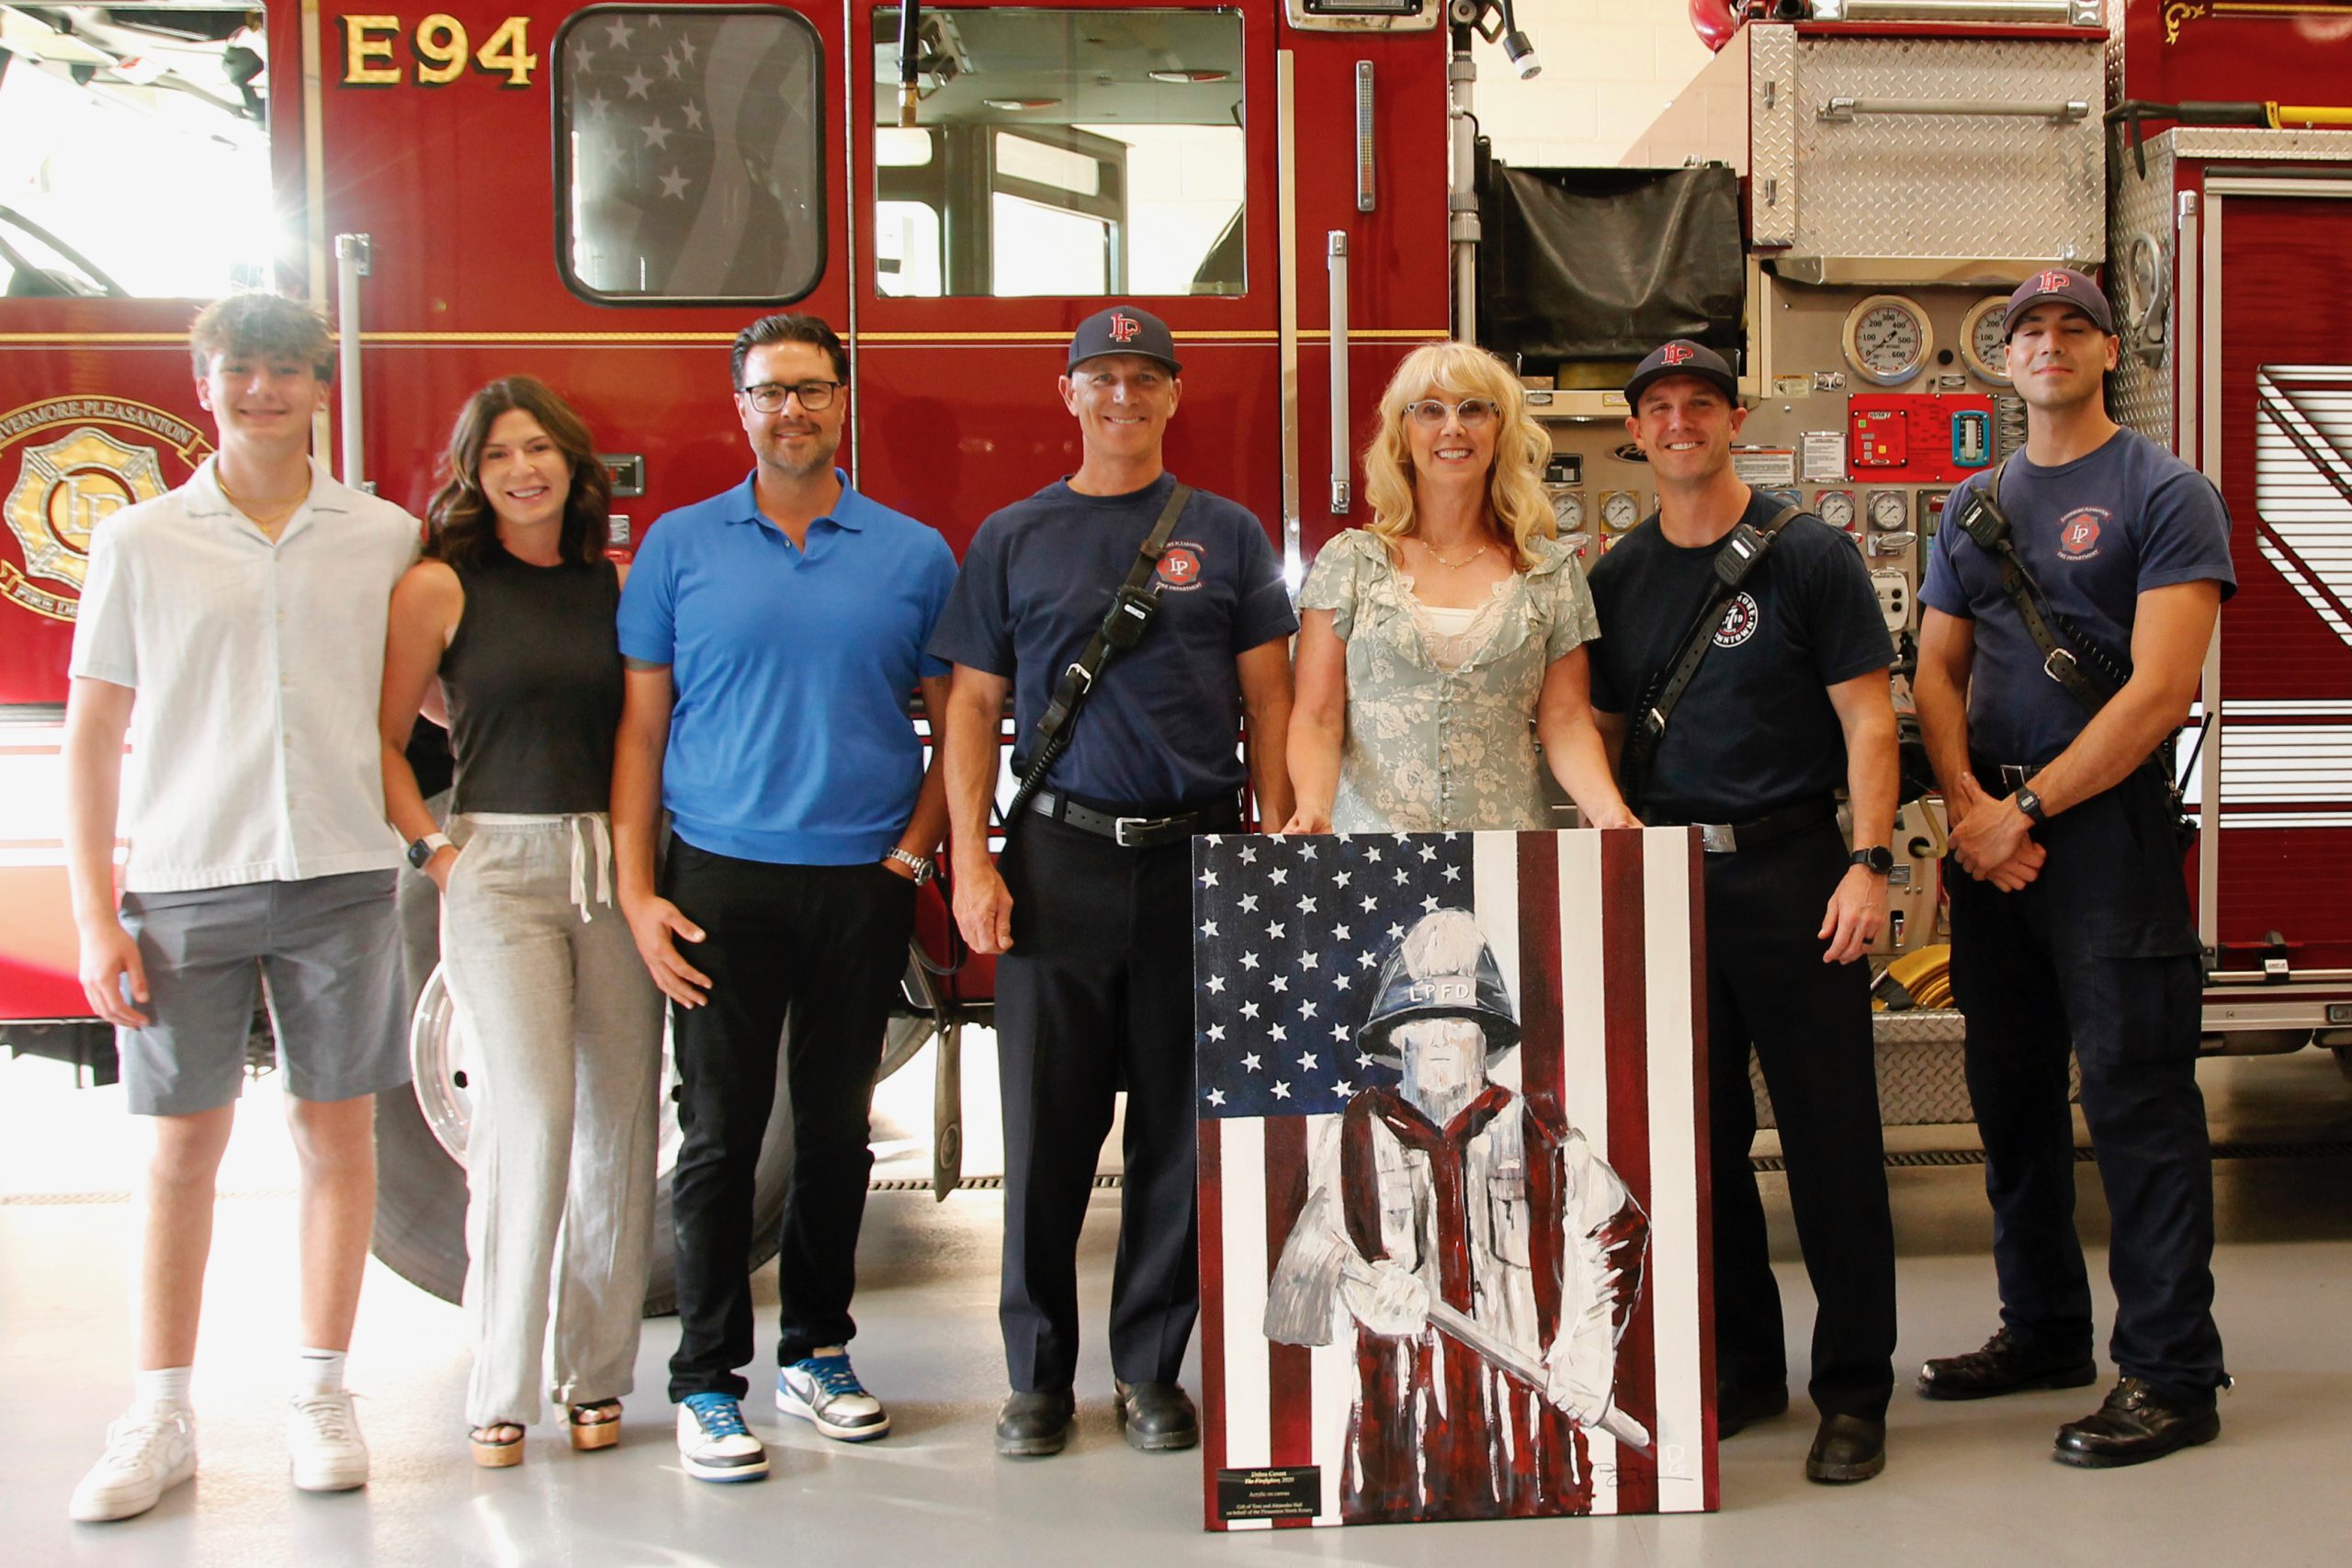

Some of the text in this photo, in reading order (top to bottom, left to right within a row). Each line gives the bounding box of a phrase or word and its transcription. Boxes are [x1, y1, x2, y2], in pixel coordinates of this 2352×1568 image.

[339, 13, 538, 85] E94
[2037, 271, 2070, 293] LP
[1109, 312, 1141, 343] LP
[1661, 344, 1694, 366] LP
[2071, 524, 2089, 544] LP
[1170, 557, 1189, 576] LP
[1409, 983, 1470, 1002] LPFD
